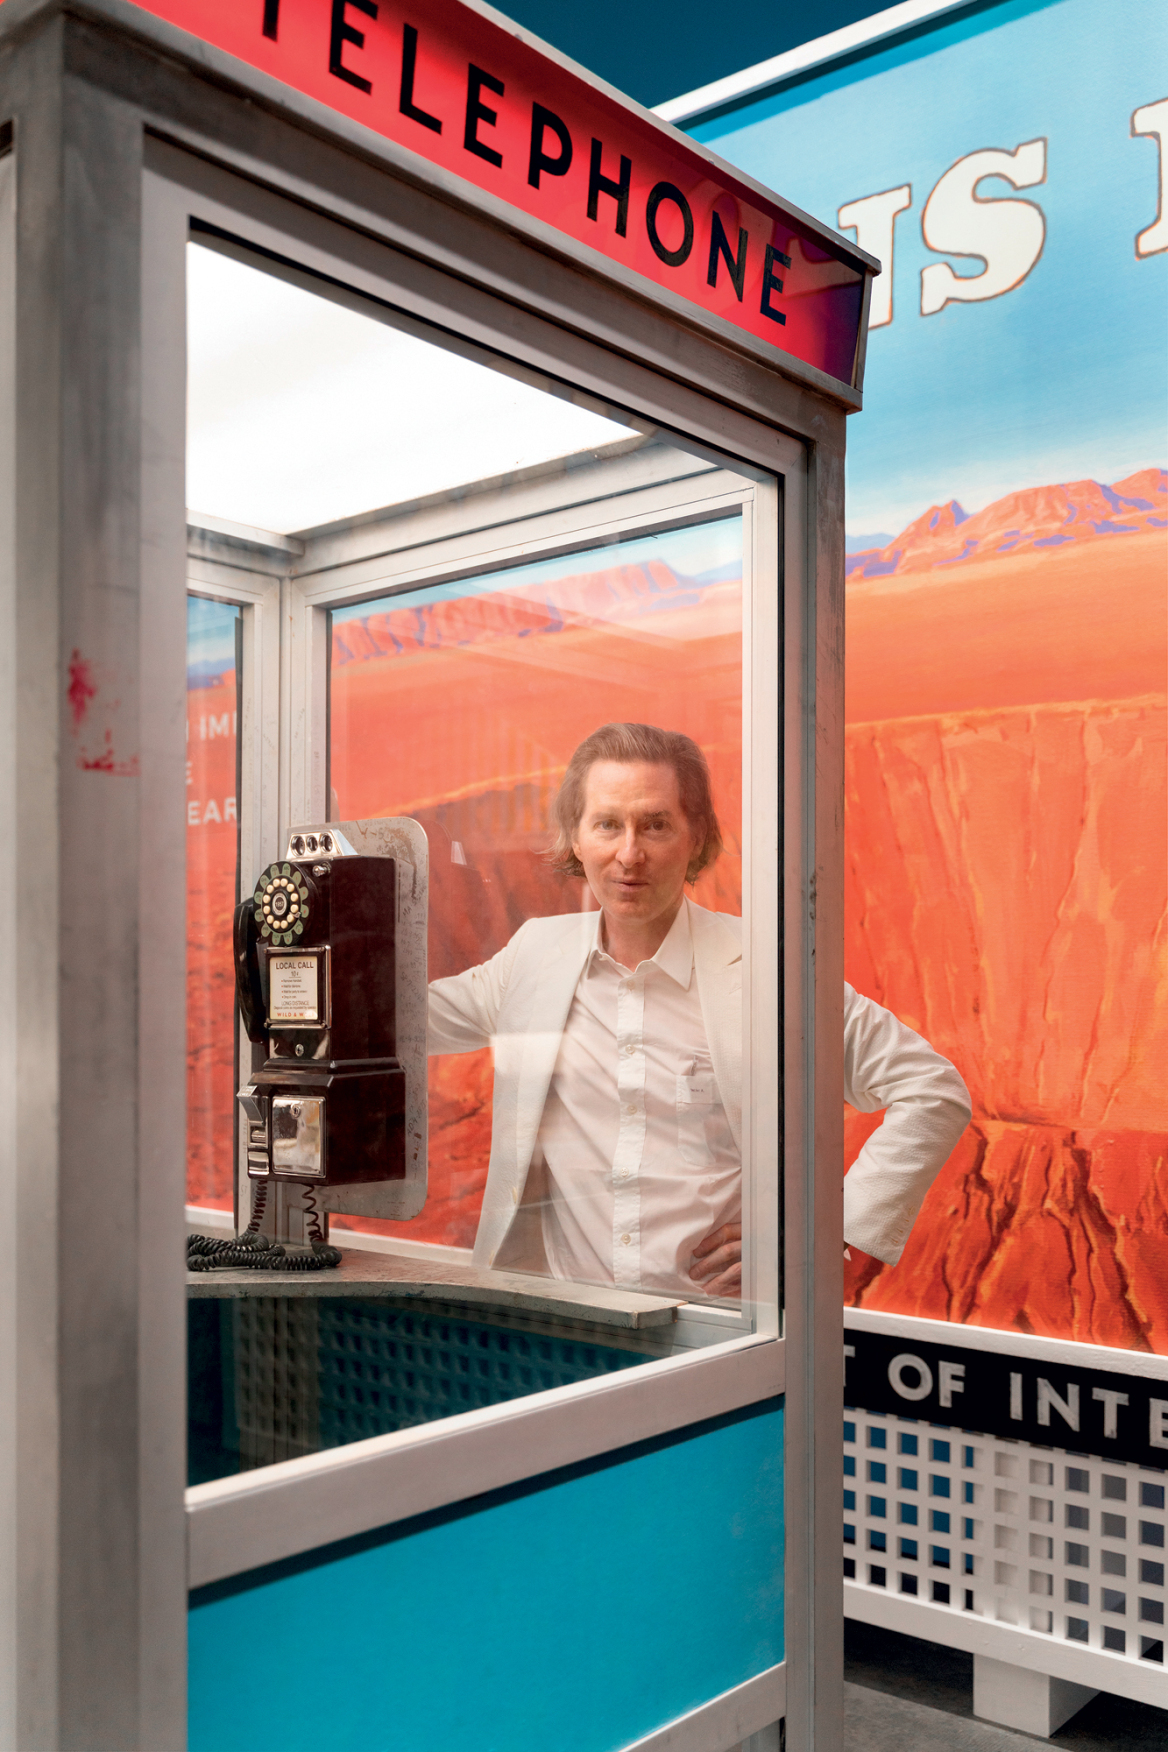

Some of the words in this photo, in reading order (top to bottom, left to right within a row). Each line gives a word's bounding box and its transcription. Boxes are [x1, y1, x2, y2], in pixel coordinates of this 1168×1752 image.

[275, 962, 297, 970] LOCAL
[297, 961, 314, 969] CALL
[887, 1353, 966, 1408] OF
[1009, 1371, 1168, 1449] INTE
